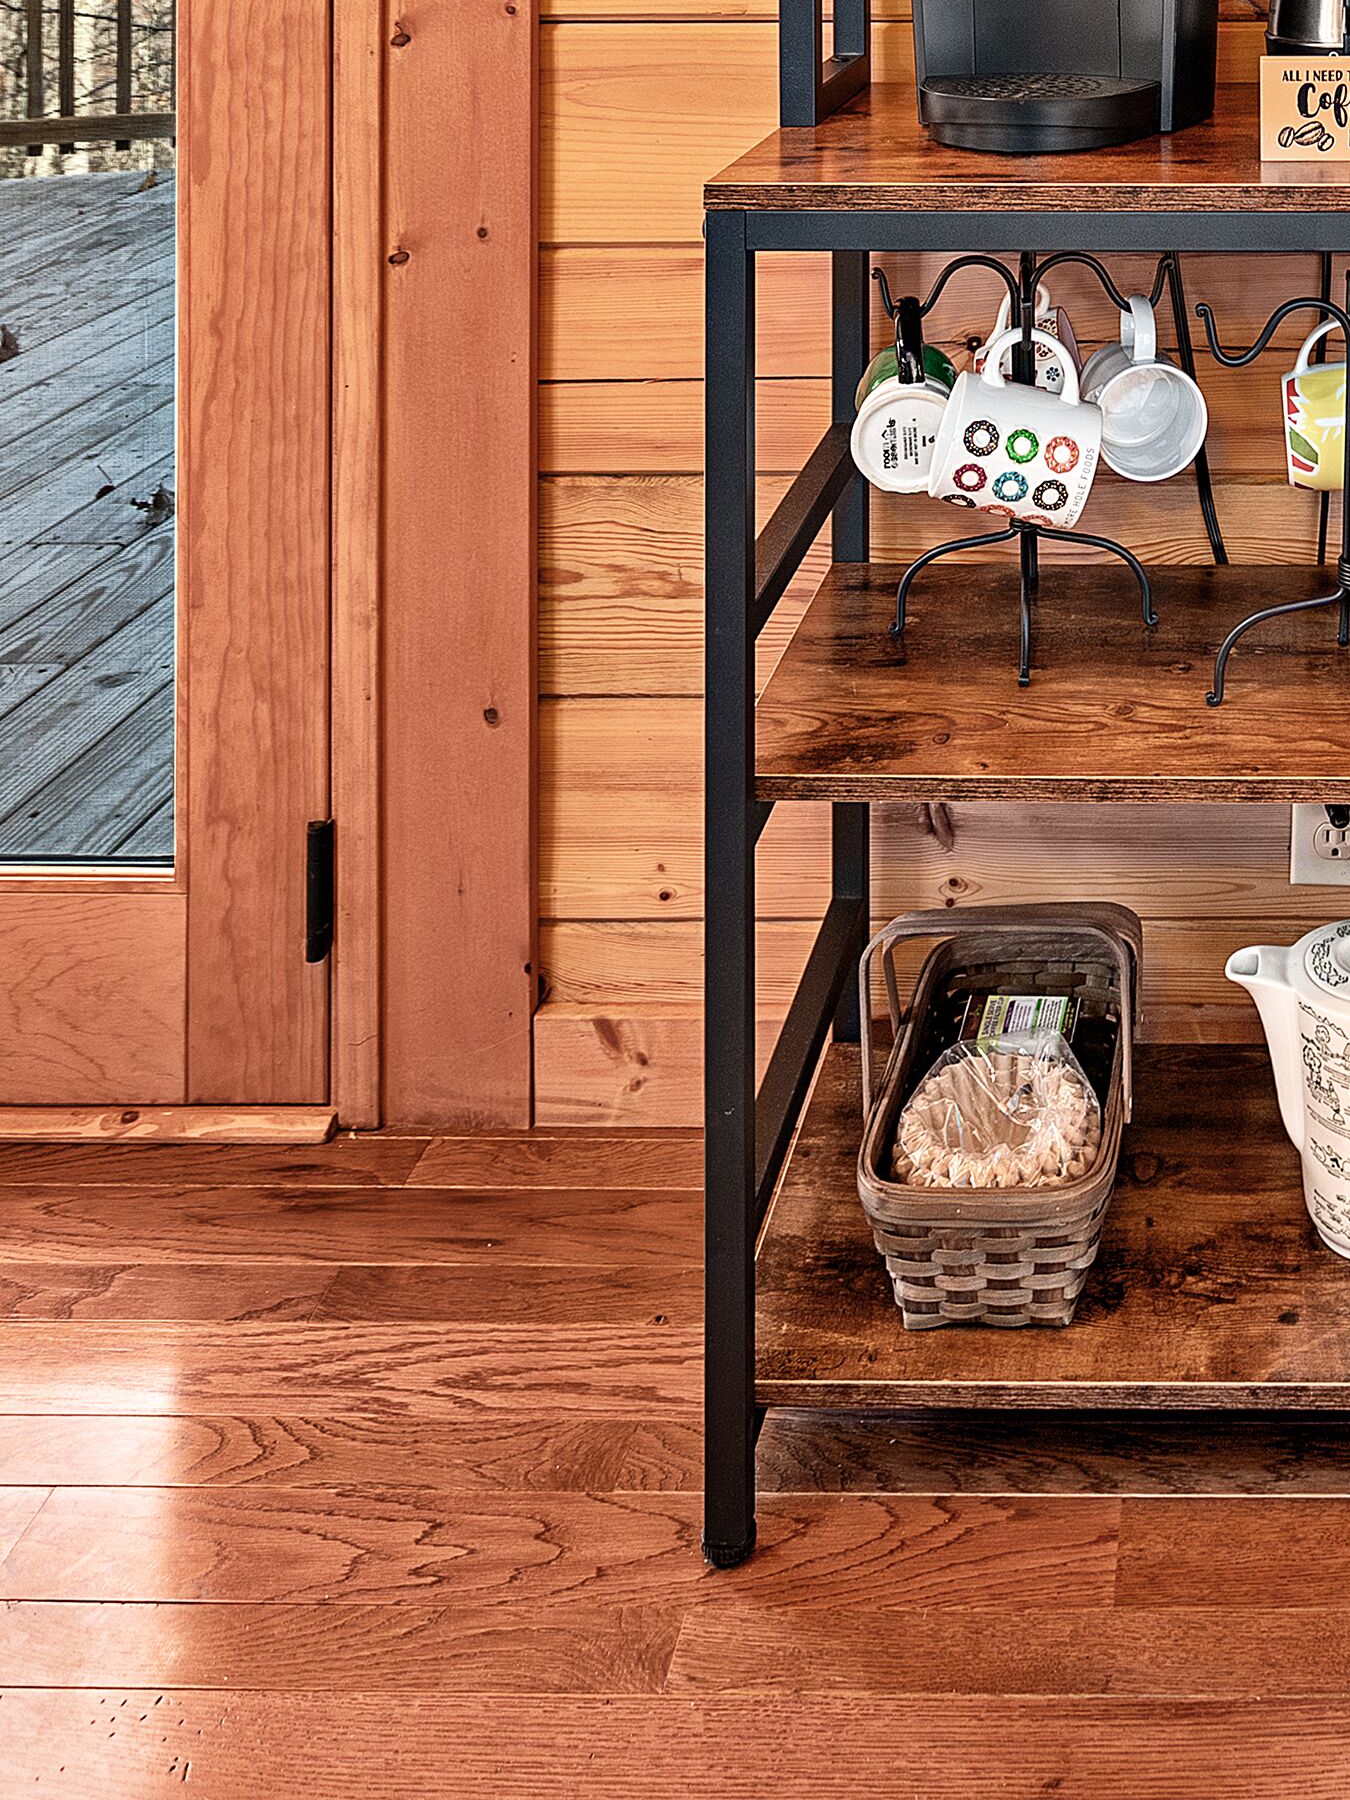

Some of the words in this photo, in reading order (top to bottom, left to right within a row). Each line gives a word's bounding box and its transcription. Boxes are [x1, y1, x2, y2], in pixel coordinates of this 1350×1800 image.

[1282, 69, 1302, 82] ALL
[1306, 69, 1310, 82] I
[1313, 69, 1343, 82] NEED
[1072, 483, 1087, 507] HOLE
[1080, 447, 1095, 481] FOODS
